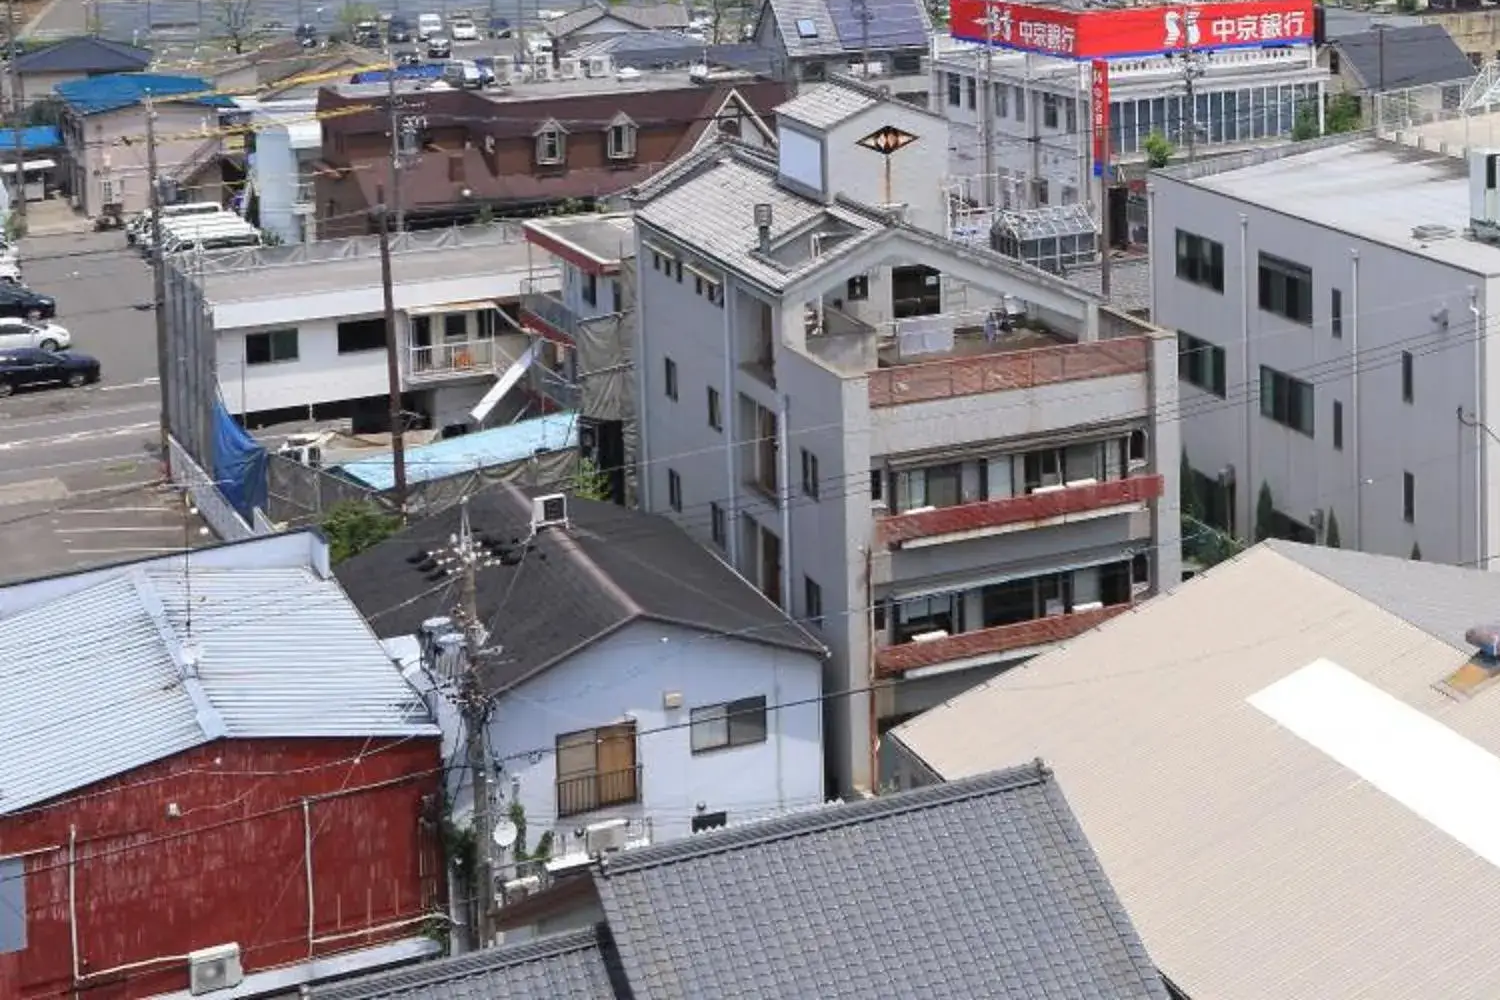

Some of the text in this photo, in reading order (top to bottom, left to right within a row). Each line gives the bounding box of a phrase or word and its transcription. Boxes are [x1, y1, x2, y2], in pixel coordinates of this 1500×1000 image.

[1019, 21, 1076, 53] 中京銀行
[1211, 11, 1305, 43] 中京銀行
